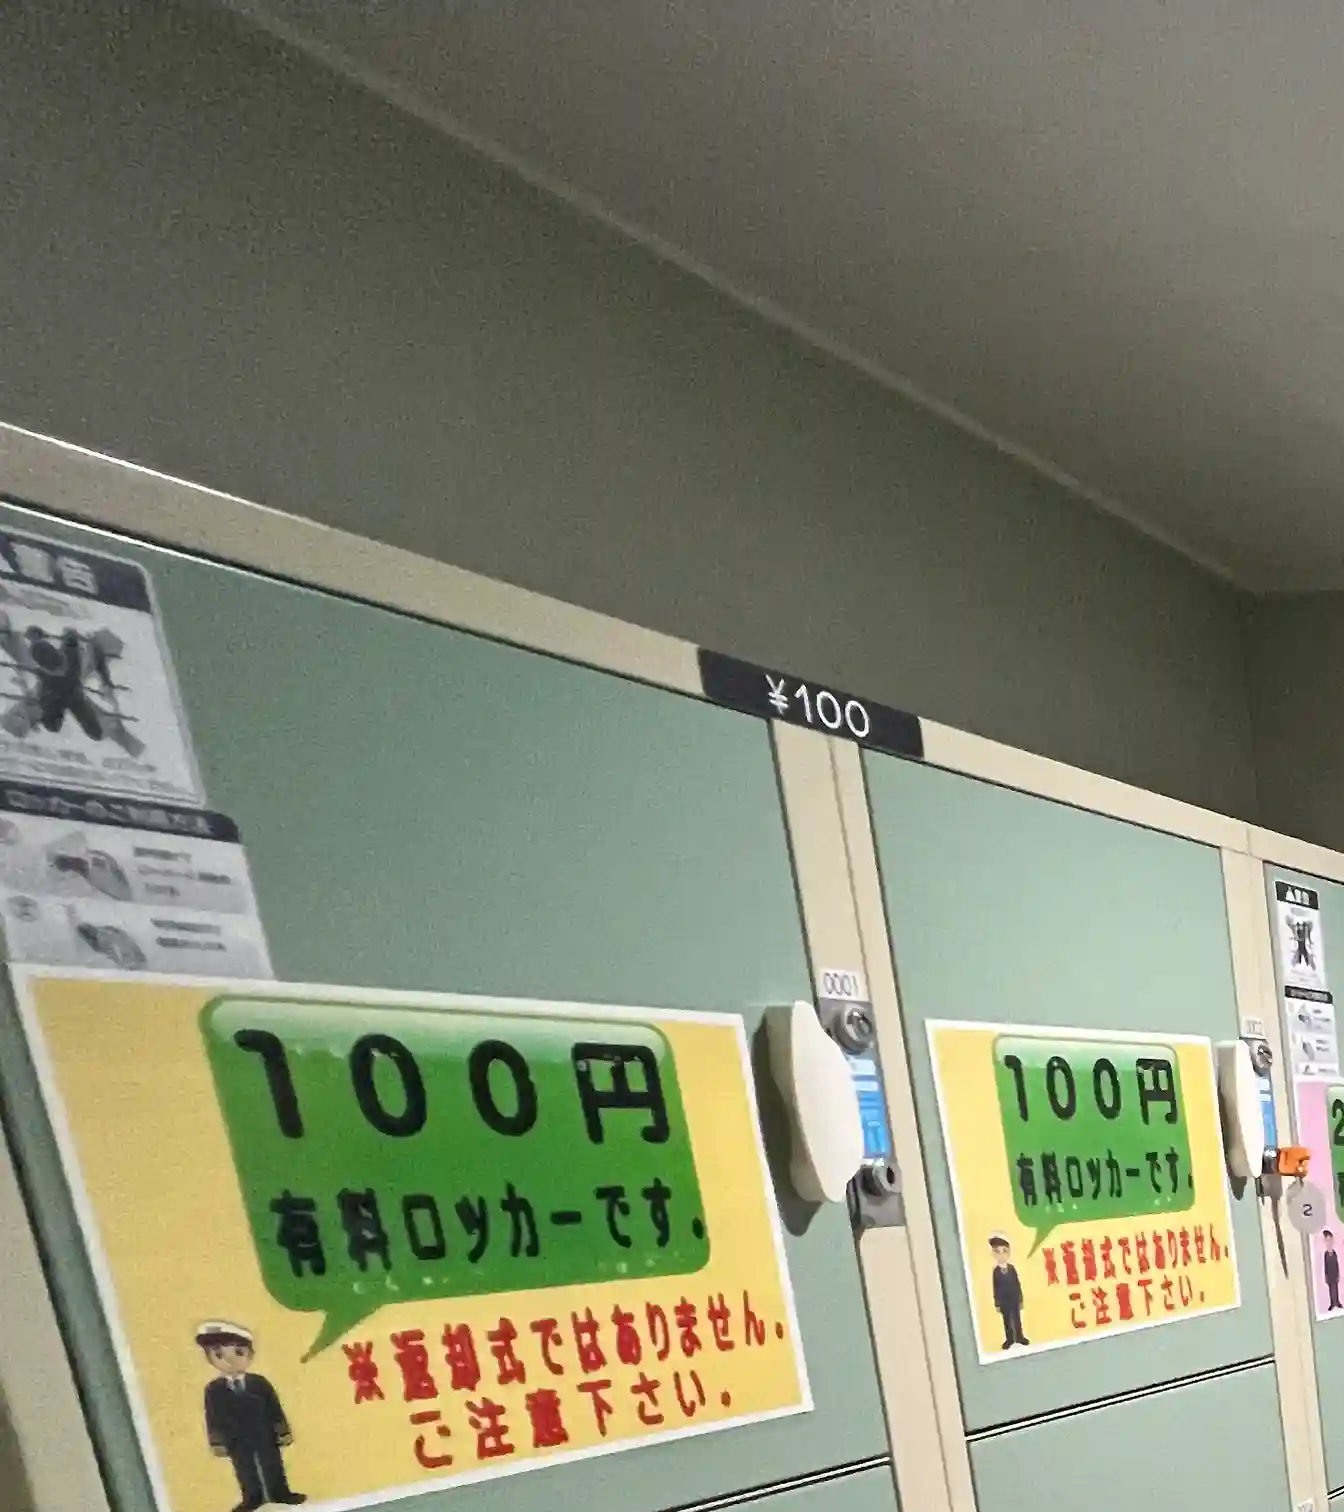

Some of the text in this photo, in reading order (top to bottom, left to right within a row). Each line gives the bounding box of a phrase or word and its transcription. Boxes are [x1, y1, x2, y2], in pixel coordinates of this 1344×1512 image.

[764, 672, 872, 738] ¥100
[233, 1028, 673, 1146] 100円
[1003, 1053, 1179, 1126] 100円
[1302, 1203, 1314, 1218] 2
